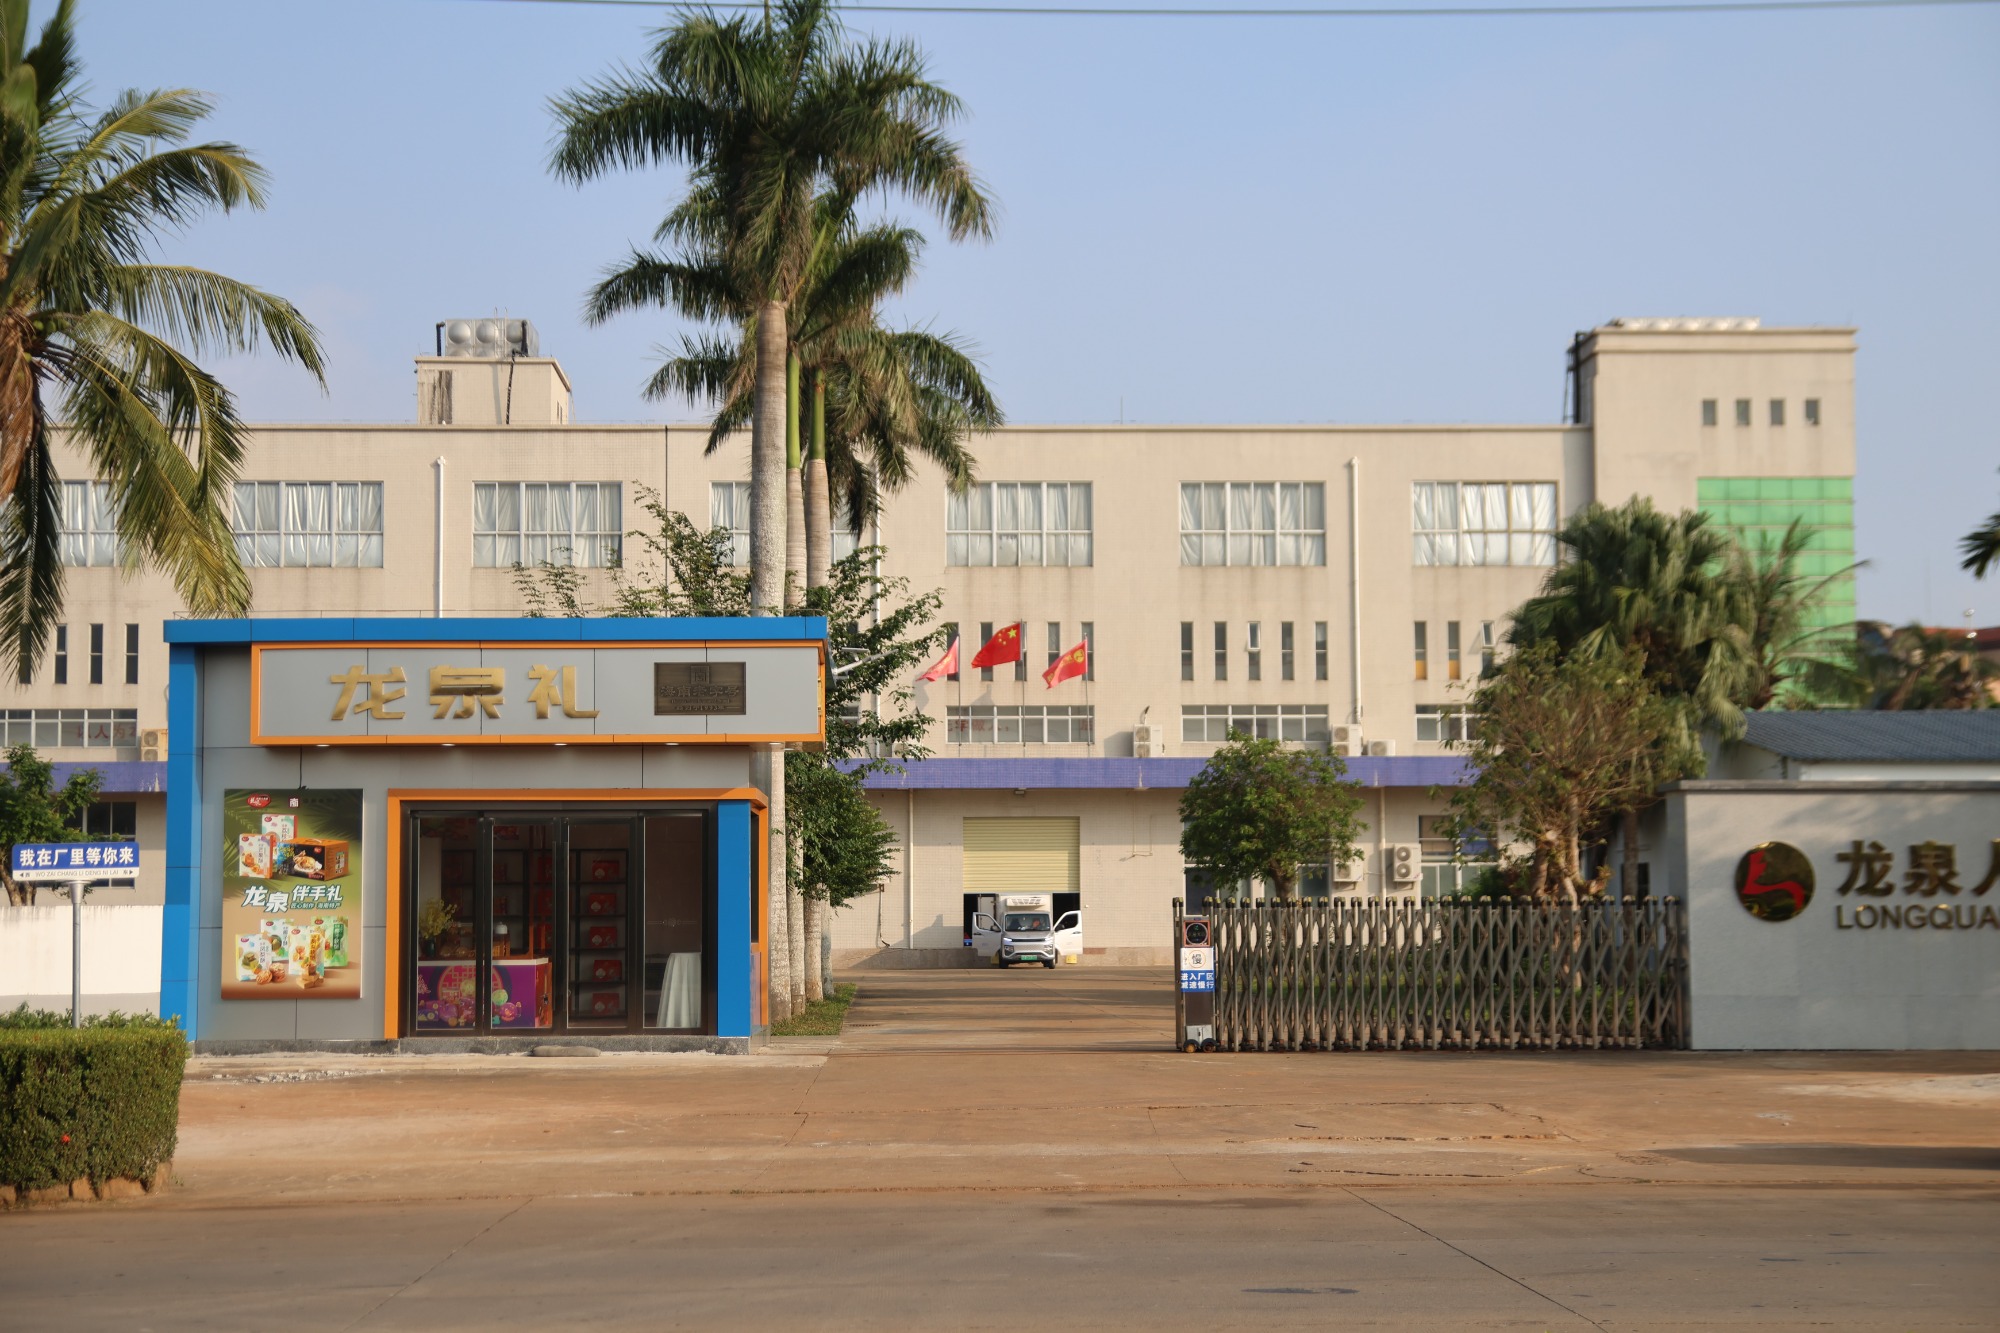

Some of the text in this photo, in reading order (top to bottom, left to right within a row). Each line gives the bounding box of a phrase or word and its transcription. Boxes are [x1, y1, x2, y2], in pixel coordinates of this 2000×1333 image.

[329, 664, 600, 721] 龙泉礼
[20, 847, 133, 866] 我在厂里等你来
[243, 885, 342, 912] 龙泉 伴手礼
[1192, 954, 1202, 964] 慢
[1181, 972, 1214, 981] 进入厂区
[1181, 981, 1214, 989] 减速慢行
